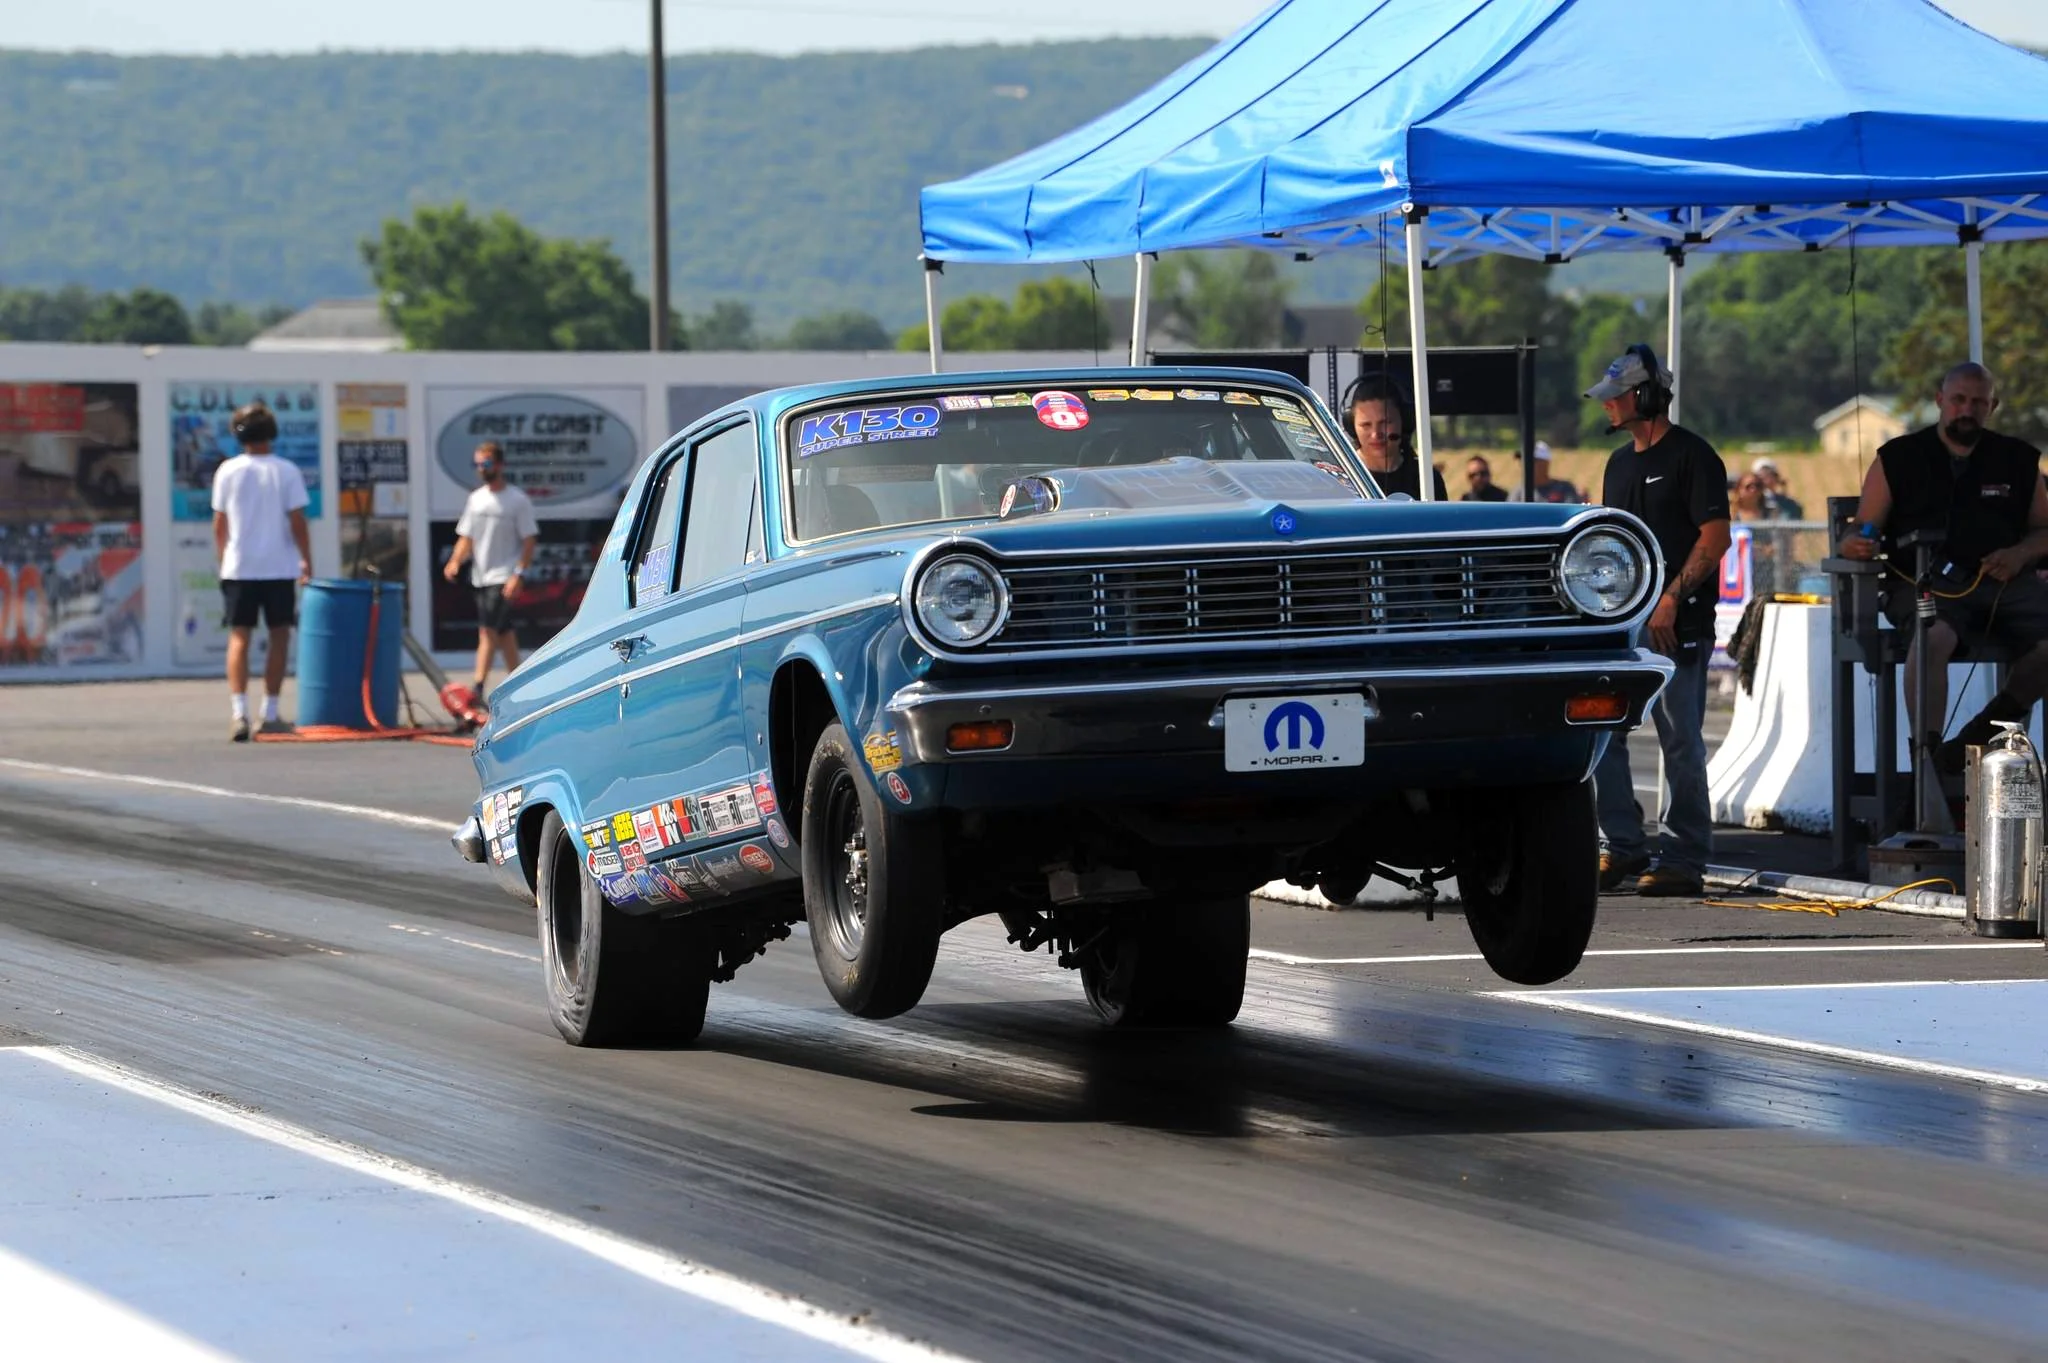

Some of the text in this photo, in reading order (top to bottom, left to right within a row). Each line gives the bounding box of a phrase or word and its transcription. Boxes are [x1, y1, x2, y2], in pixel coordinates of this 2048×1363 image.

[468, 413, 607, 435] EAST COAST
[798, 405, 941, 447] K130
[800, 427, 939, 457] SUPER STREET
[1264, 754, 1324, 766] MOPAR
